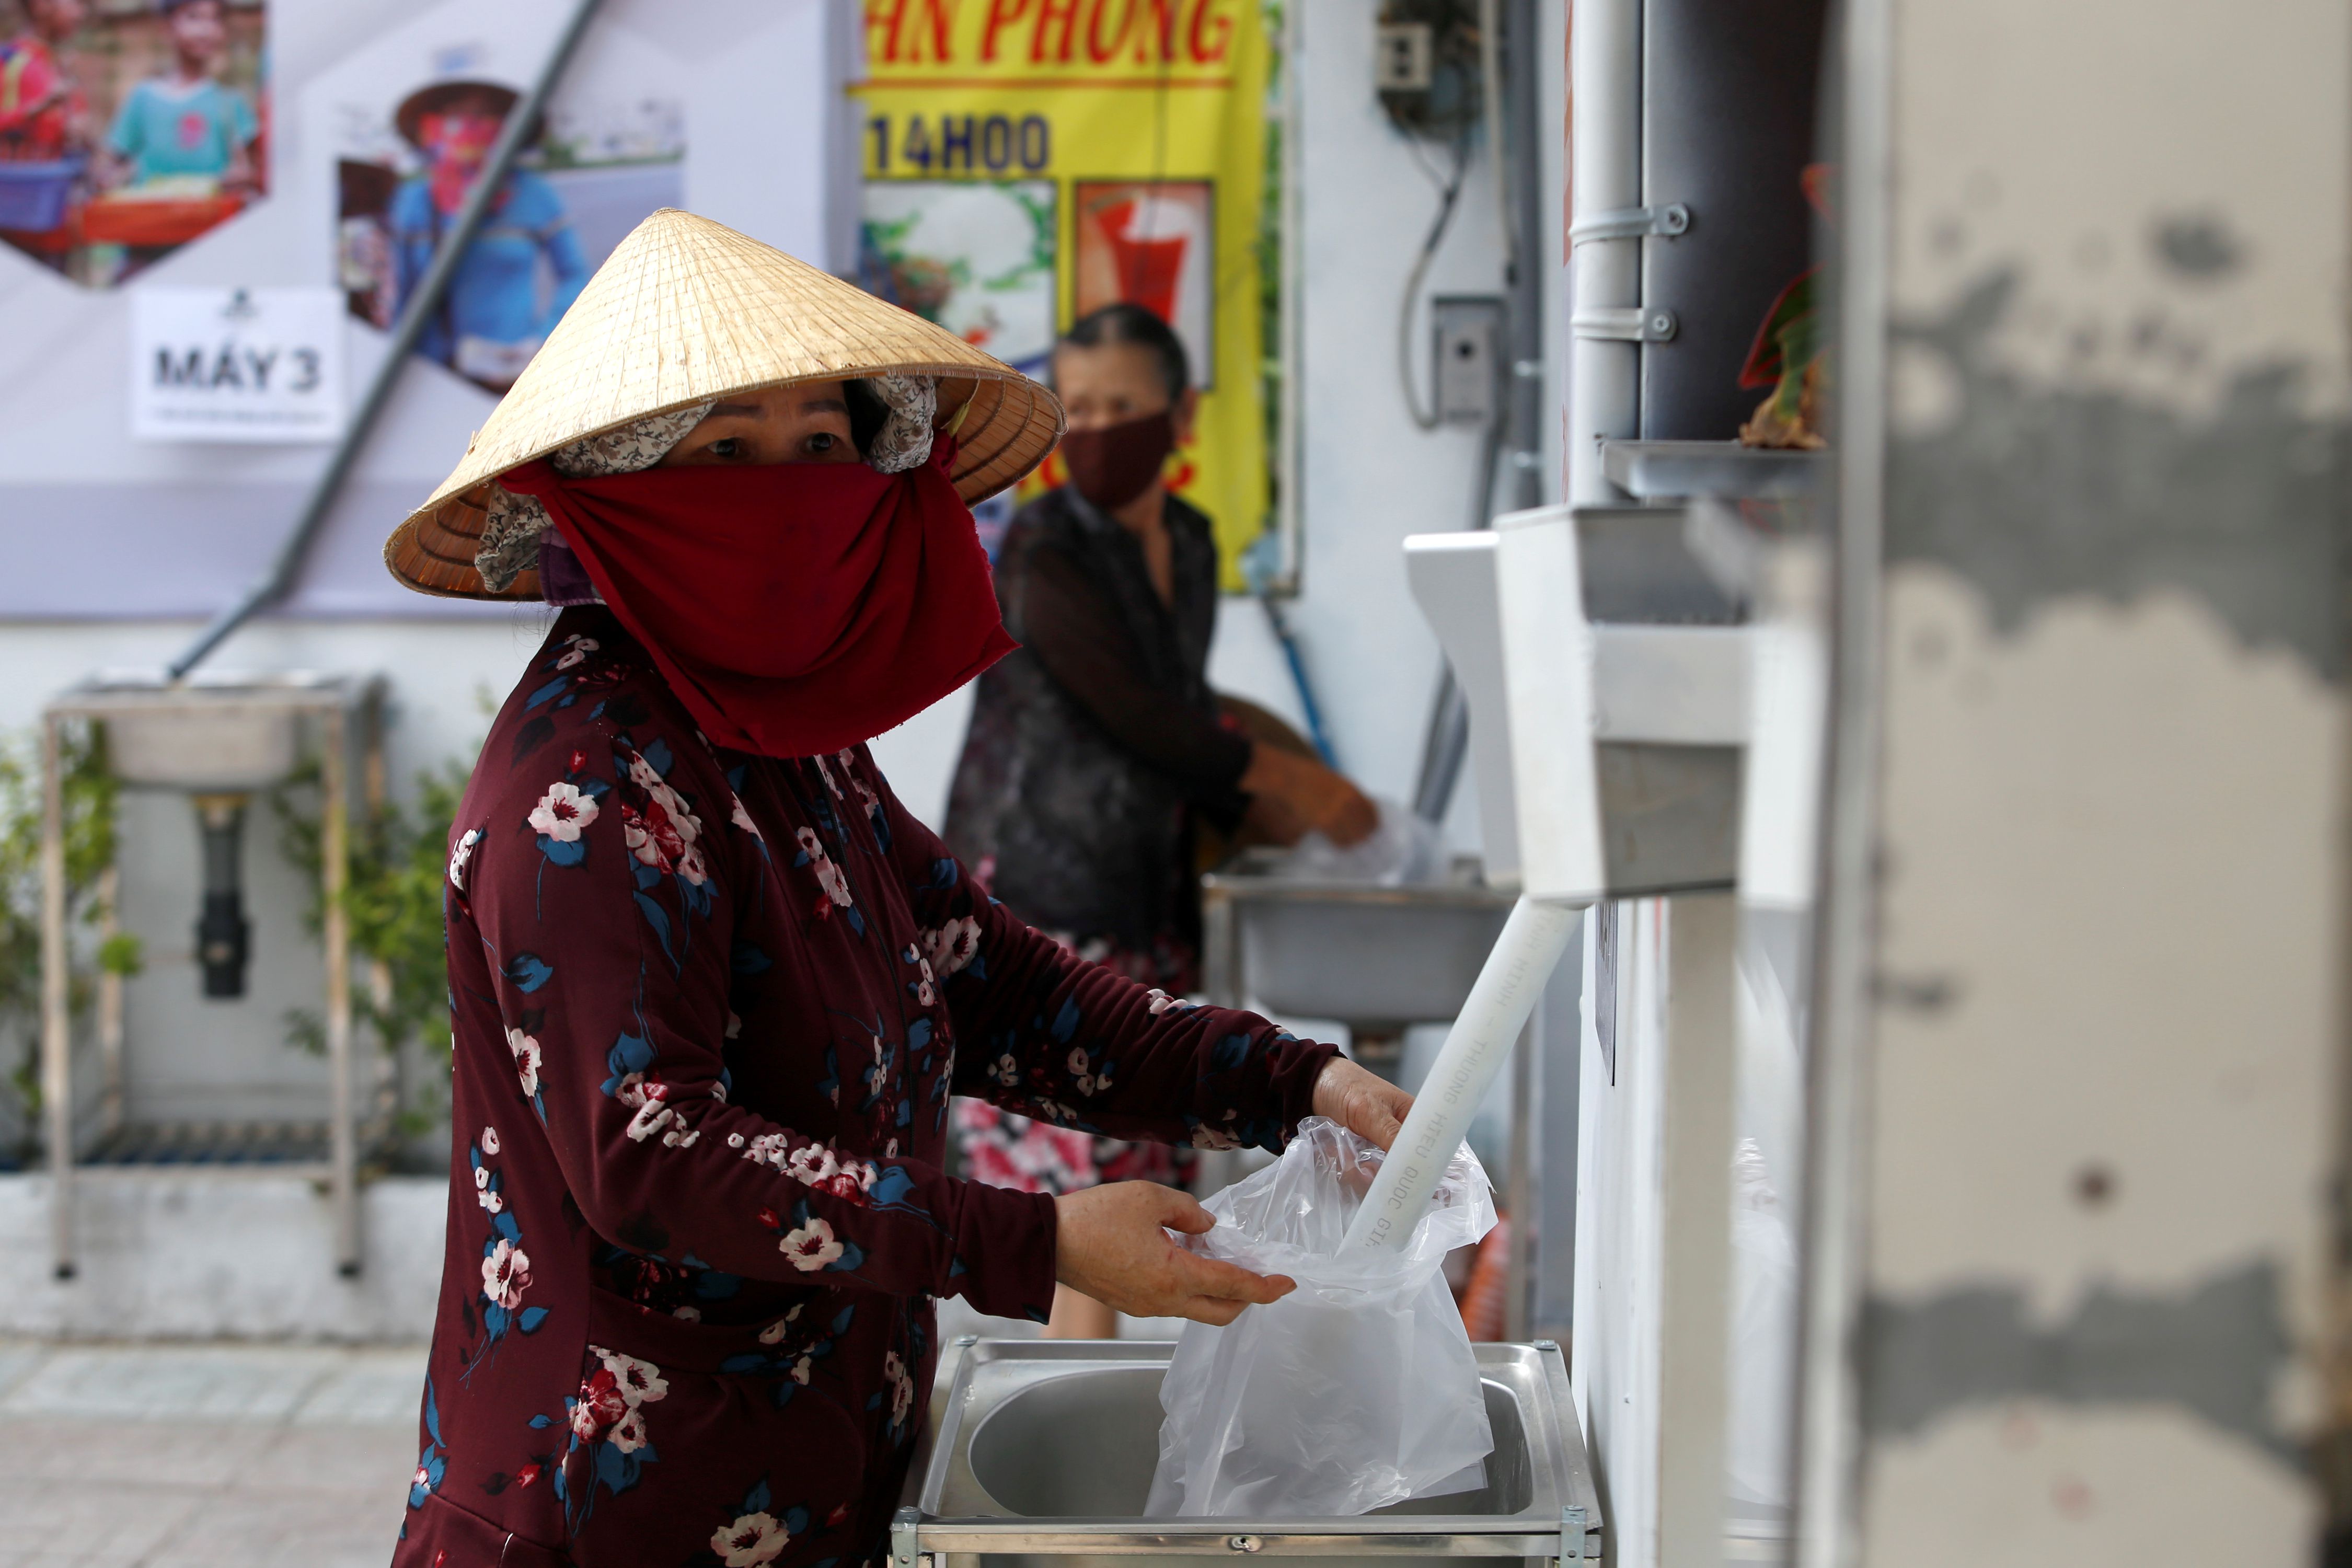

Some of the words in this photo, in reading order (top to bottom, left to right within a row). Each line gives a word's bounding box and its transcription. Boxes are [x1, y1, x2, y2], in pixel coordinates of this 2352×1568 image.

[155, 337, 279, 390] MÁY
[290, 346, 321, 392] 3
[1495, 959, 1528, 1007] MINH
[1444, 1038, 1488, 1105] THUONG
[1416, 1112, 1447, 1158] HIEU
[1388, 1166, 1419, 1209] QUOC
